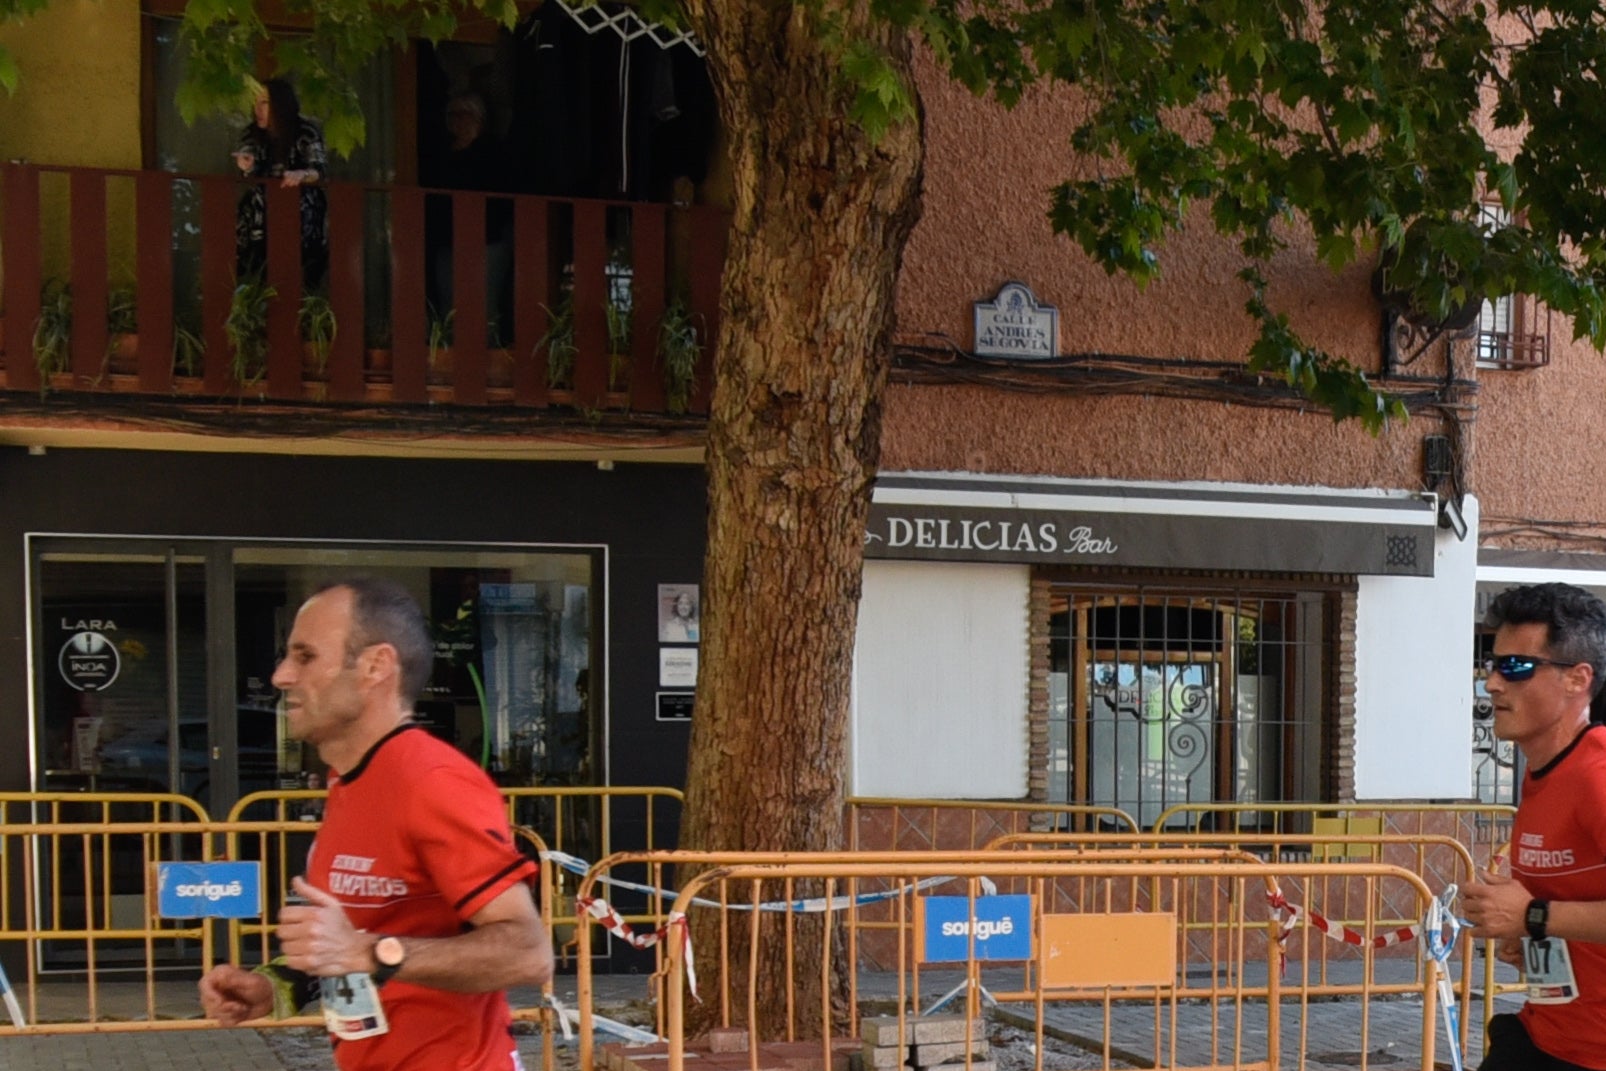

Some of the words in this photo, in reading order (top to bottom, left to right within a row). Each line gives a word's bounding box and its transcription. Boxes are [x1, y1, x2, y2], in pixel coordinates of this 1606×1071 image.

[993, 314, 1034, 325] CALLE
[979, 336, 1049, 350] SEGOVIA
[887, 517, 1058, 553] DELICIAS
[1063, 525, 1118, 554] Bar
[61, 618, 118, 630] LARA
